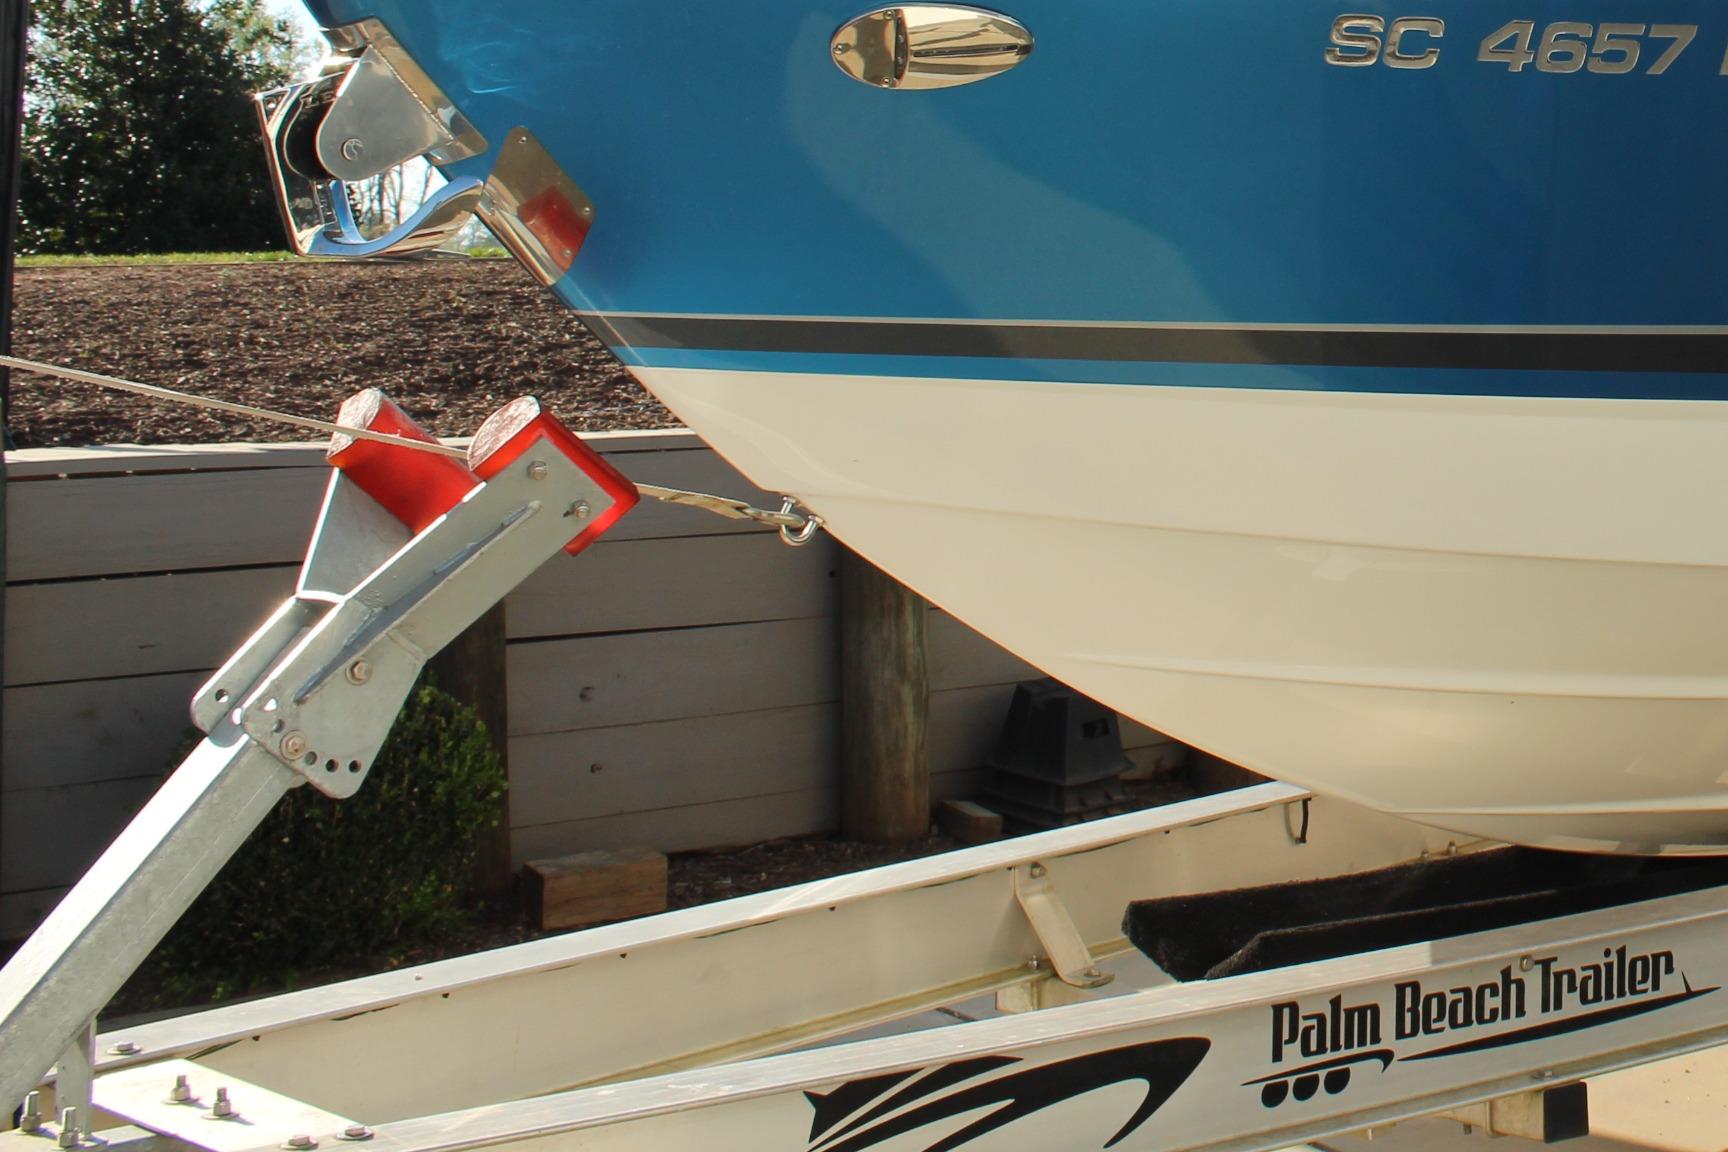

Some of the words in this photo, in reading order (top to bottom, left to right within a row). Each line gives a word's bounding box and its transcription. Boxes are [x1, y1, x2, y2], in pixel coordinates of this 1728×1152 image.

[1324, 13, 1445, 70] SC
[1477, 19, 1698, 75] 4657
[1271, 994, 1382, 1064] Palm
[1395, 964, 1527, 1041] Beach
[1534, 944, 1675, 1014] Trailer
